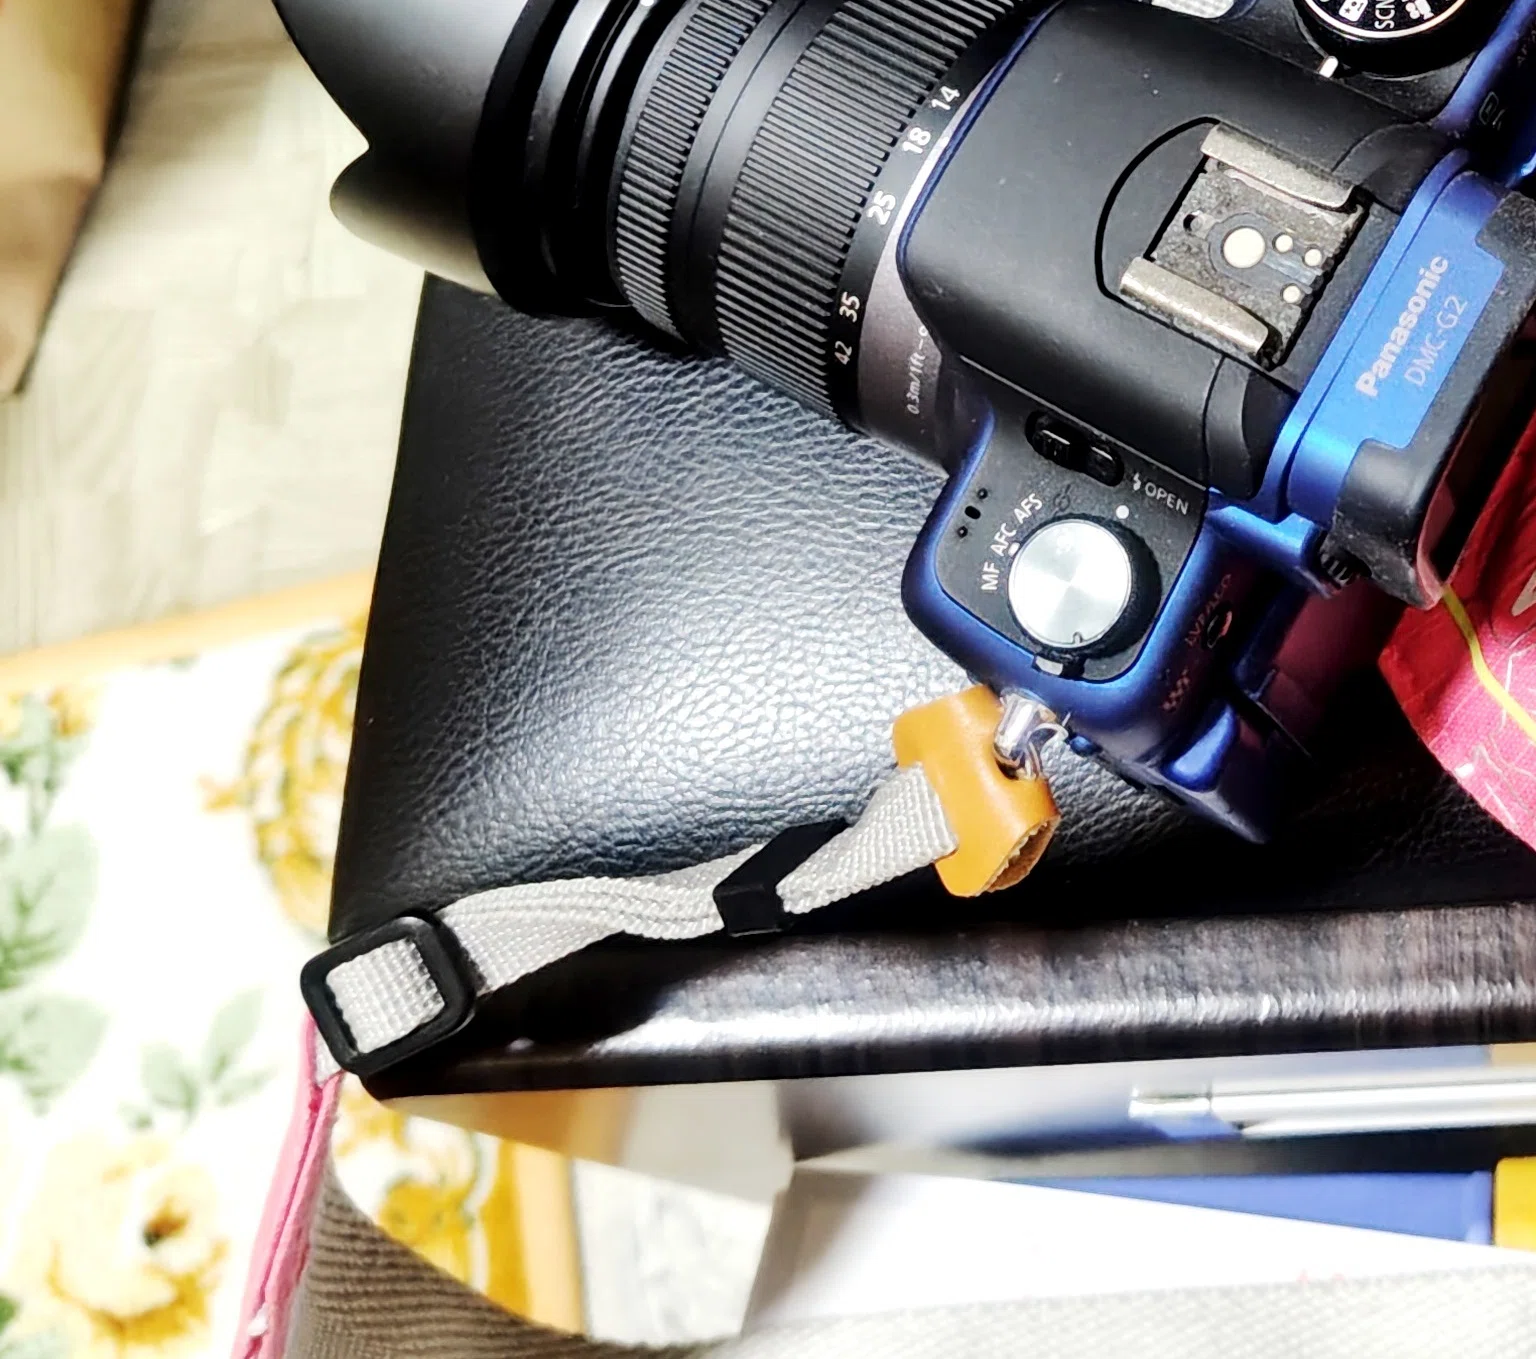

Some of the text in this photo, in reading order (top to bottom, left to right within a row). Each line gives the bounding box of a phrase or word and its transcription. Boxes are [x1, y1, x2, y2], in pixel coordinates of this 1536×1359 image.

[931, 85, 960, 111] 14
[903, 126, 932, 154] 18
[867, 190, 896, 226] 25
[839, 291, 861, 323] 35
[1355, 256, 1449, 397] Panasonic
[1404, 295, 1469, 387] DMC-G2
[834, 341, 853, 366] 42
[1013, 492, 1044, 524] AFS
[1144, 481, 1189, 516] OPEN
[990, 522, 1017, 557] AFC
[980, 561, 1000, 591] MF
